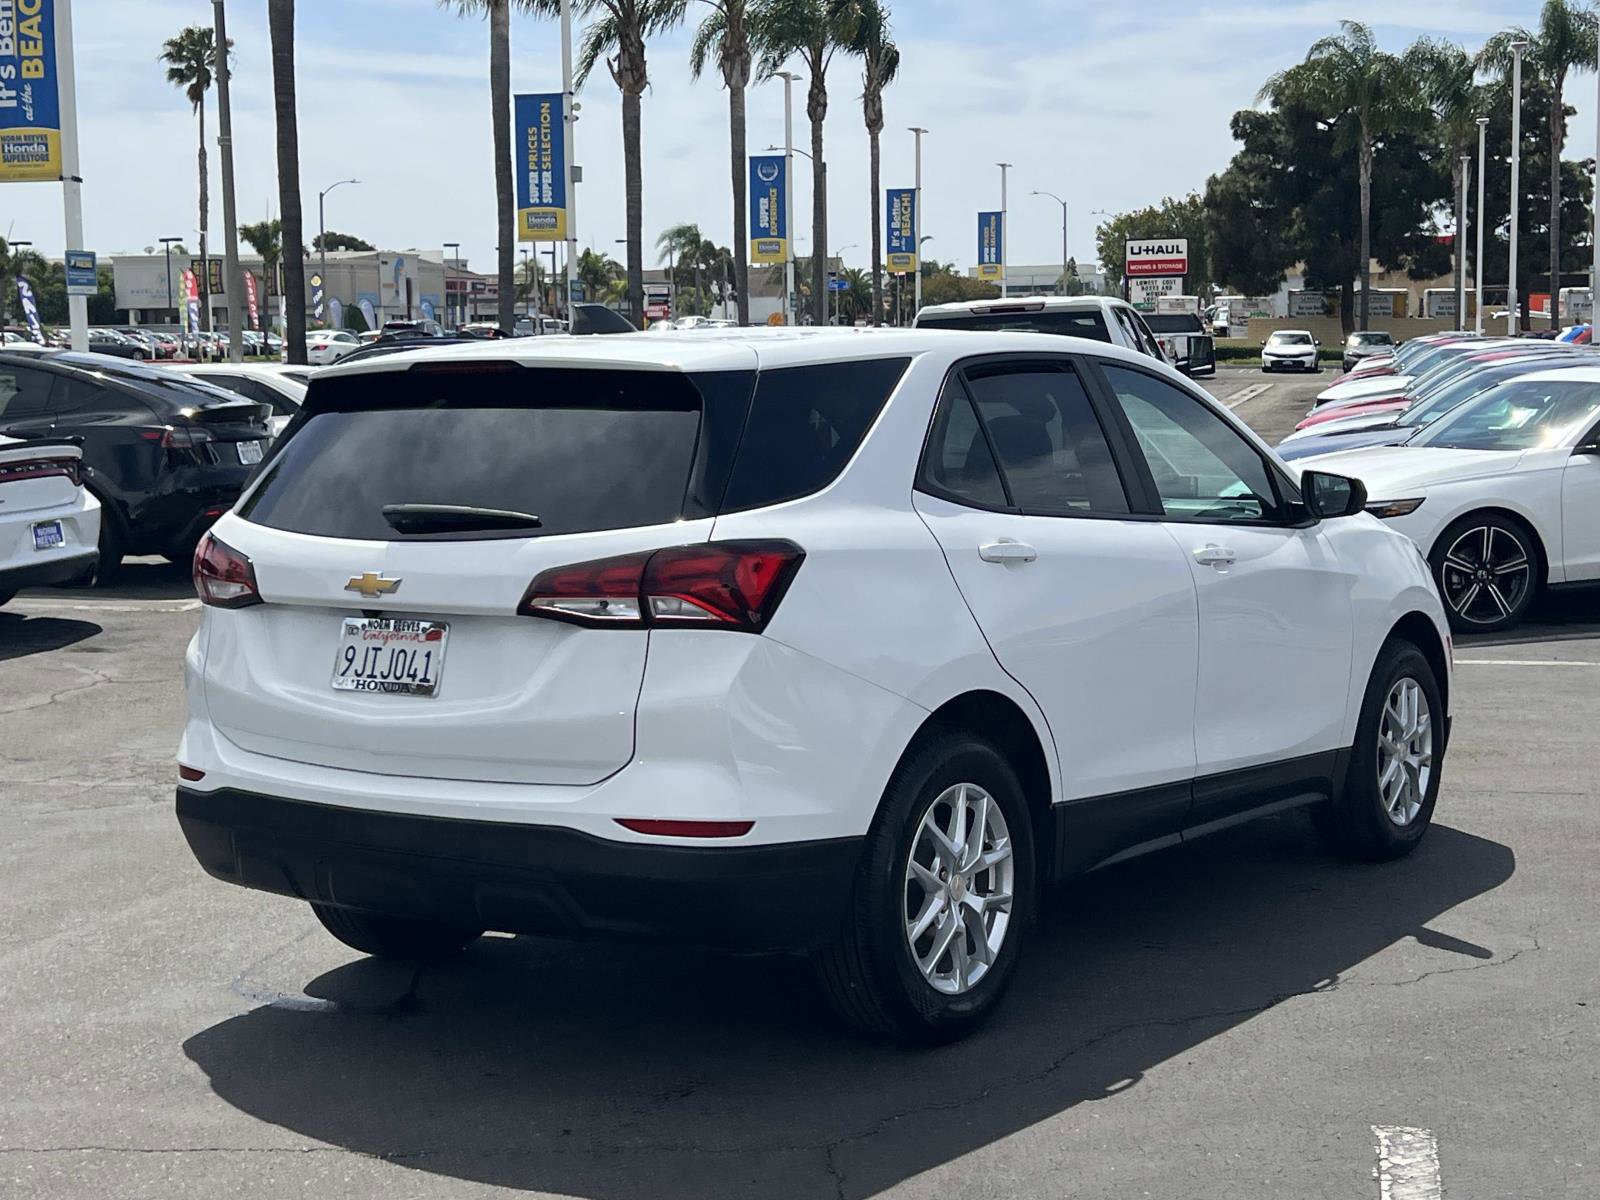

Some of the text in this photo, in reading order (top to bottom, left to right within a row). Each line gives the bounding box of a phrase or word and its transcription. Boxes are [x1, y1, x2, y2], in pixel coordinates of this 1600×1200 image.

[4, 143, 47, 153] Honda
[540, 102, 553, 204] SUPER SELECTION
[528, 126, 540, 204] SUPER PRICES
[759, 197, 769, 228] SUPER
[891, 196, 901, 229] Better
[901, 192, 912, 237] BEACH!
[891, 231, 901, 247] It's
[1130, 245, 1183, 255] U-HAUL
[367, 619, 391, 631] NORM
[393, 620, 421, 632] REEVES
[362, 630, 425, 646] California
[340, 645, 432, 684] 9JIJ041
[354, 680, 411, 693] HONDA
